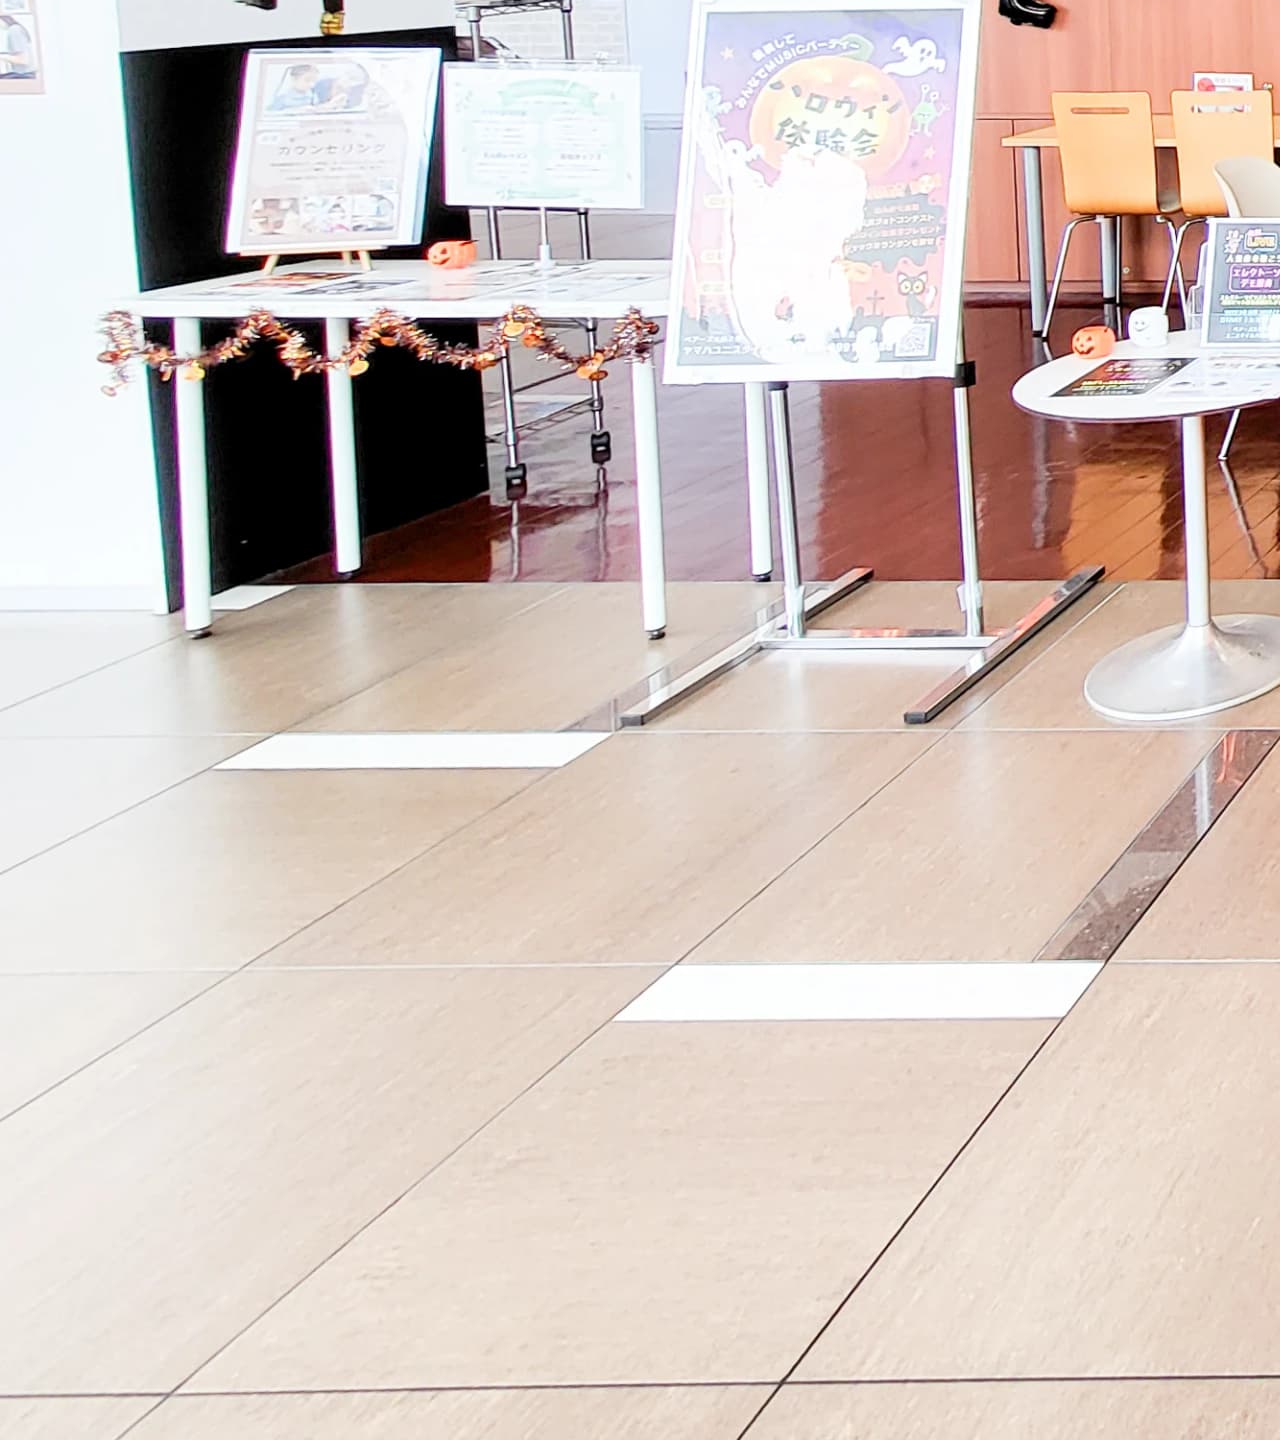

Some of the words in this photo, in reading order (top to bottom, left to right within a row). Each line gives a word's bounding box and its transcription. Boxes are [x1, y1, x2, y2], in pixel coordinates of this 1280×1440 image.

[769, 79, 902, 120] ハロウィン
[774, 116, 881, 158] 体験会
